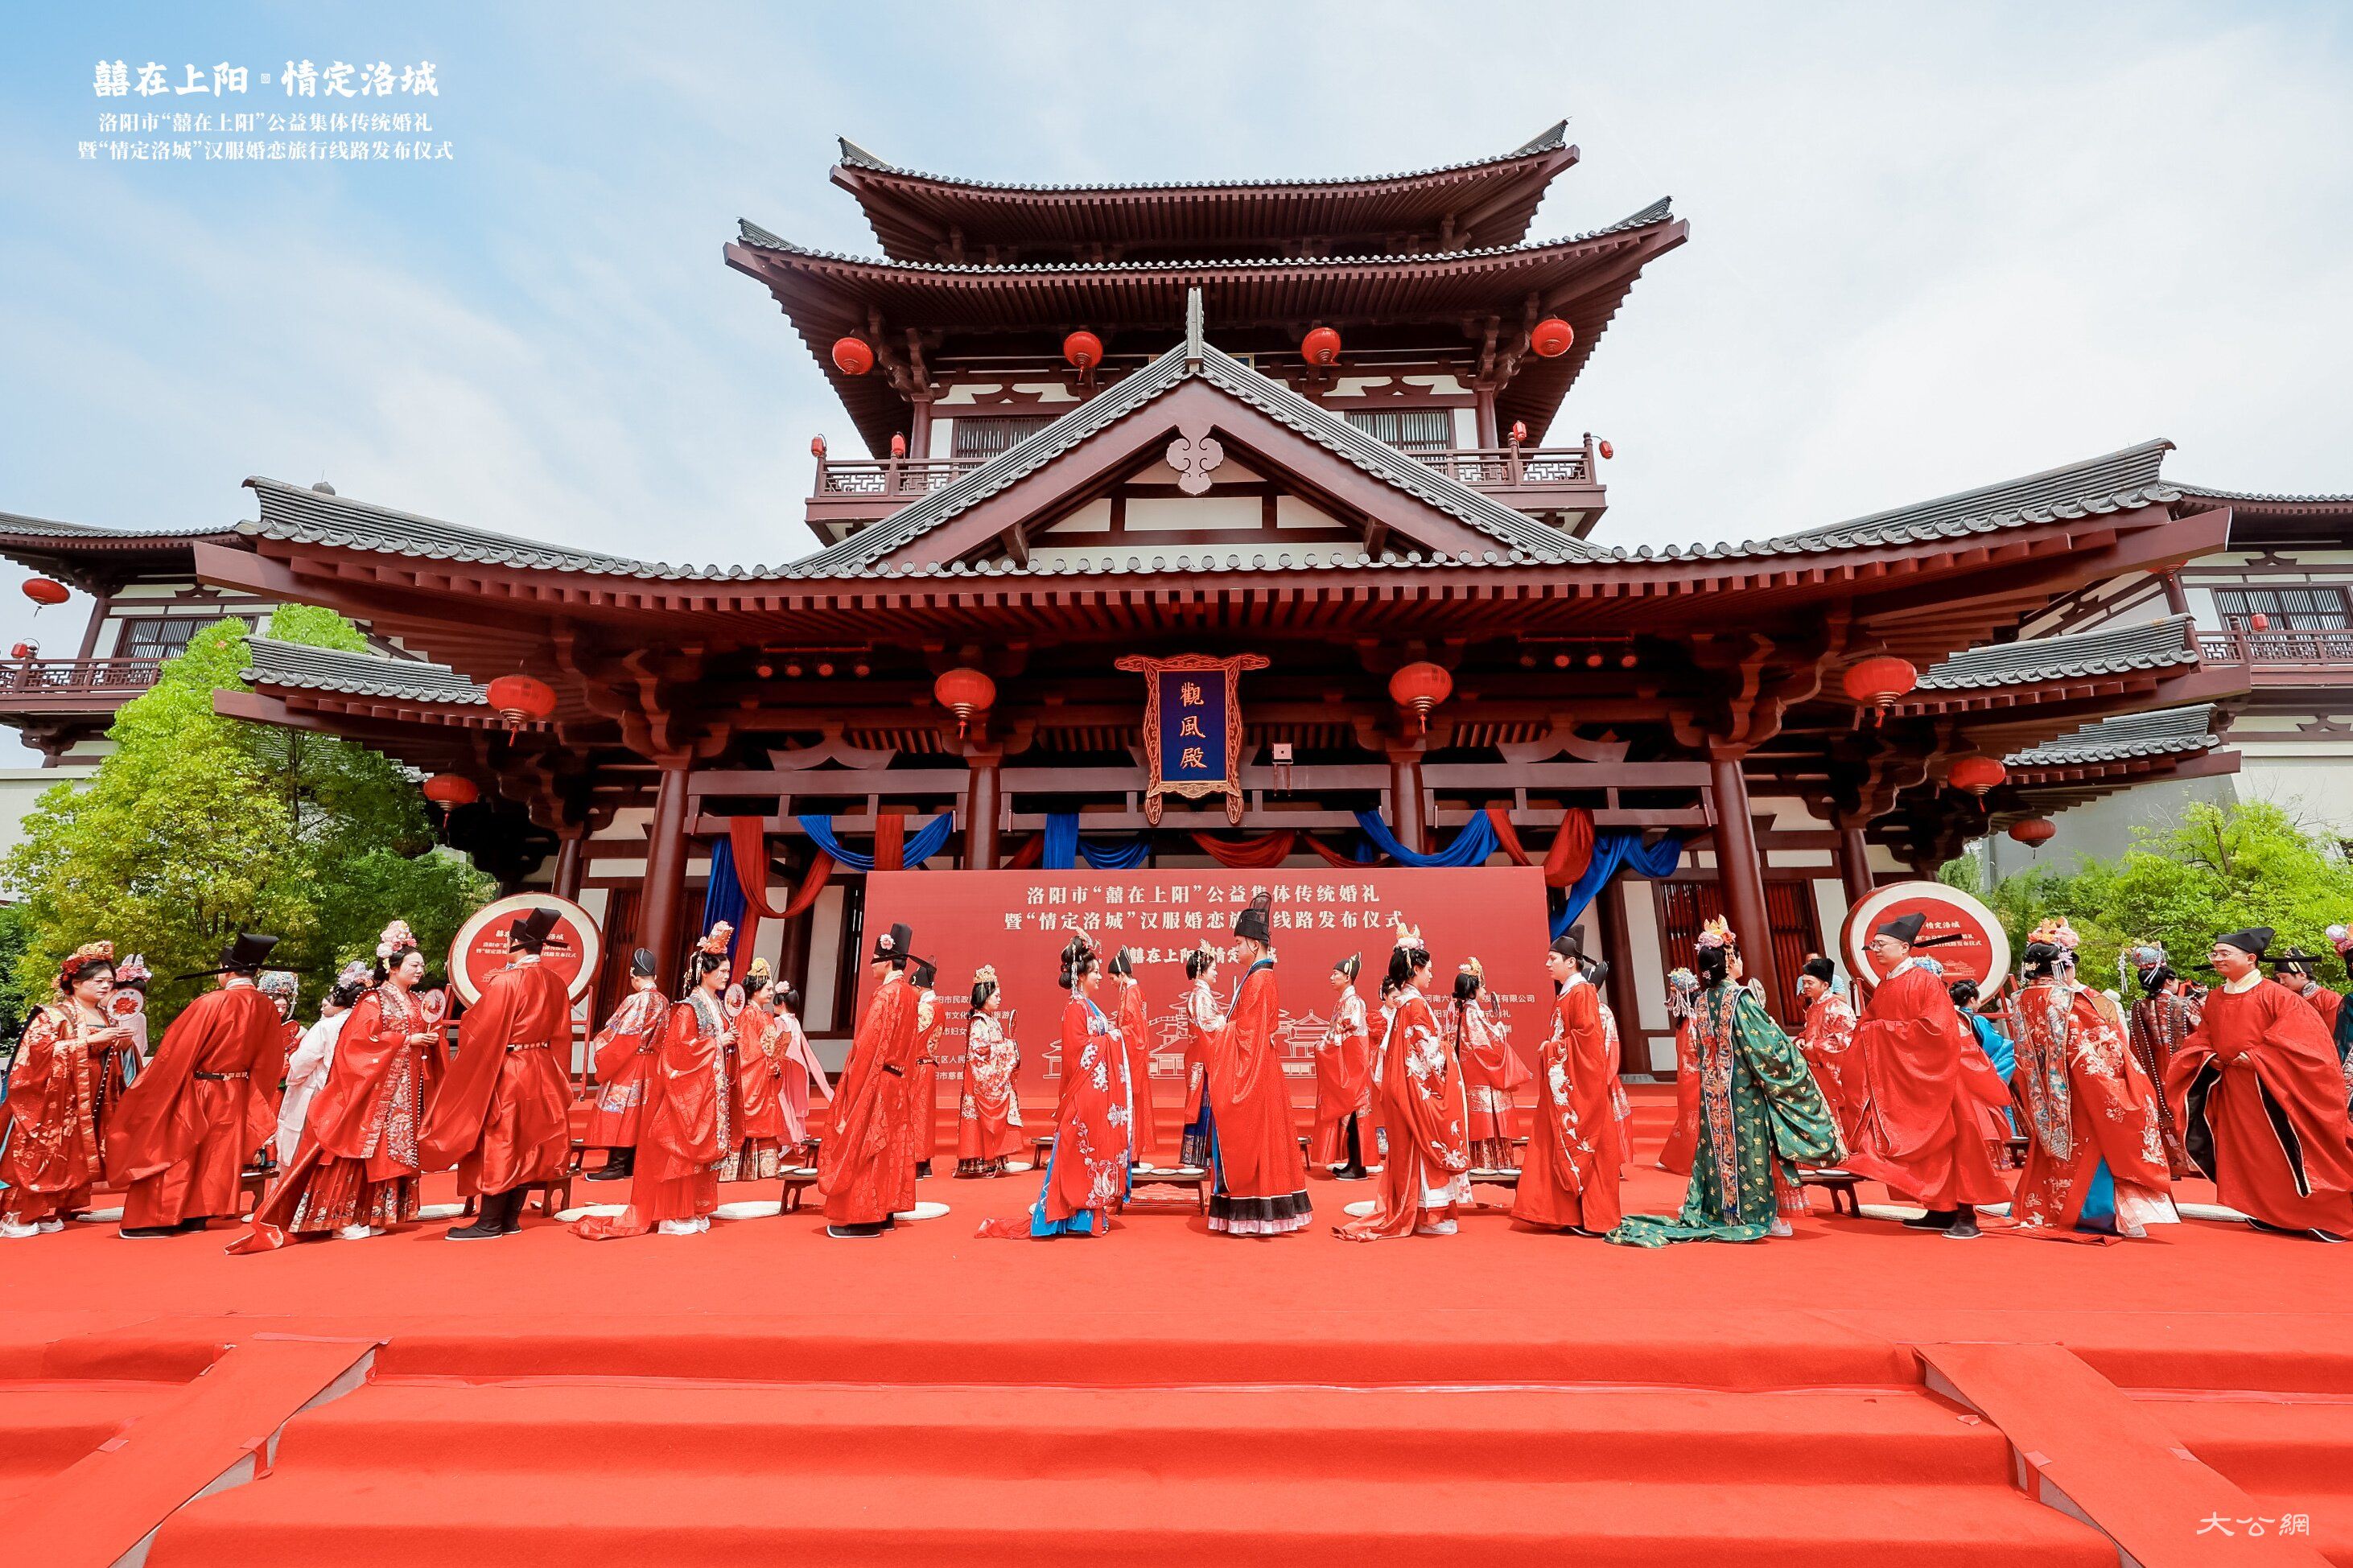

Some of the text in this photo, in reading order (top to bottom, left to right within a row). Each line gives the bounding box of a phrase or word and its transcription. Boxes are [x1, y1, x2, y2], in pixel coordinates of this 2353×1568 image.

[1180, 681, 1207, 769] 觀風殿
[1003, 910, 1403, 930] 暨“情定洛城”汉服婚恋旅线路发布仪式
